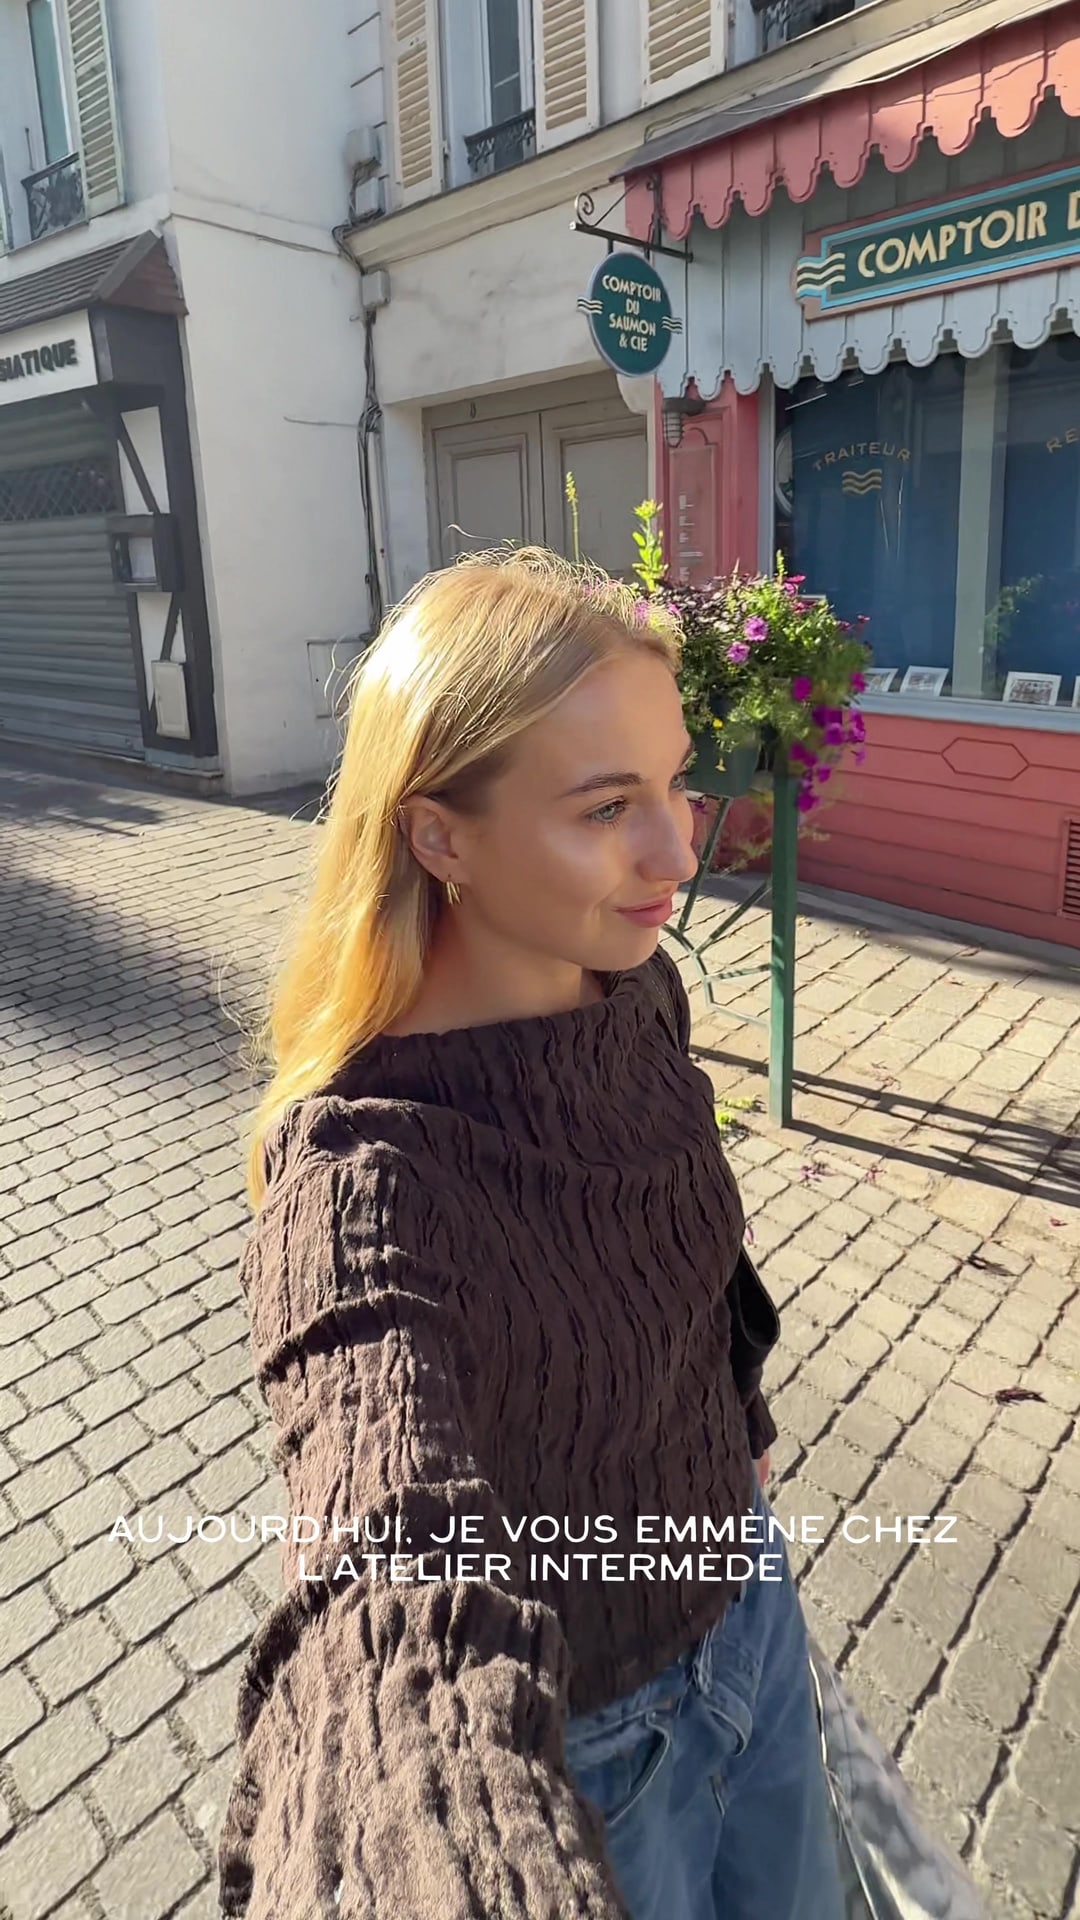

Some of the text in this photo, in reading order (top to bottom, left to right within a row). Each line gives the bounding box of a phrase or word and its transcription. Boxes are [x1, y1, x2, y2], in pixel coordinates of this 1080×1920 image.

[857, 200, 1048, 278] COMPTOIR
[602, 275, 661, 302] COMPTOIR
[625, 298, 640, 315] DU
[609, 313, 656, 336] SAUMON
[619, 334, 648, 352] & CIE
[812, 441, 912, 472] TRAITEUR
